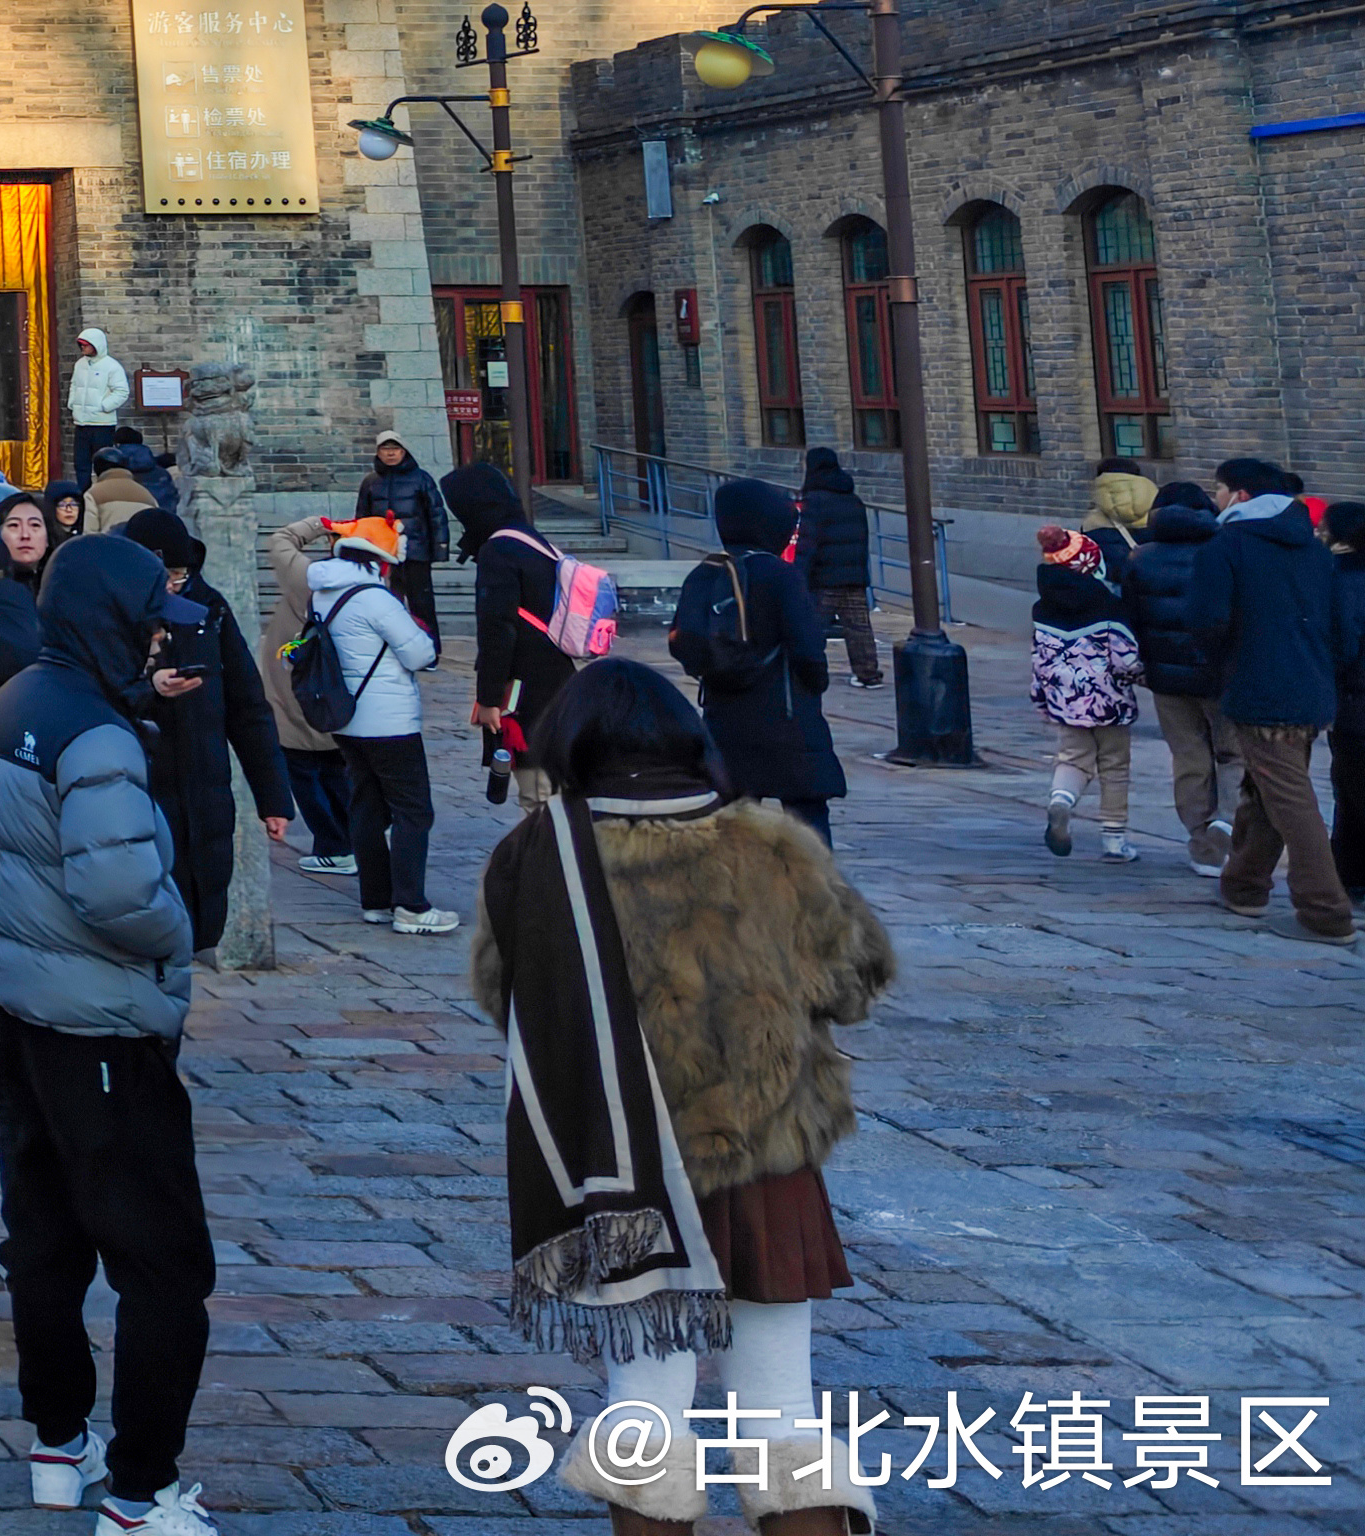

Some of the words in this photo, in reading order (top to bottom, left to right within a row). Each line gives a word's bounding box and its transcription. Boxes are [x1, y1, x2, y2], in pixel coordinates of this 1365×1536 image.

[147, 10, 295, 35] 游客服务中心
[200, 63, 264, 84] 售票处
[203, 107, 268, 127] 检票处
[205, 150, 292, 170] 住宿办理
